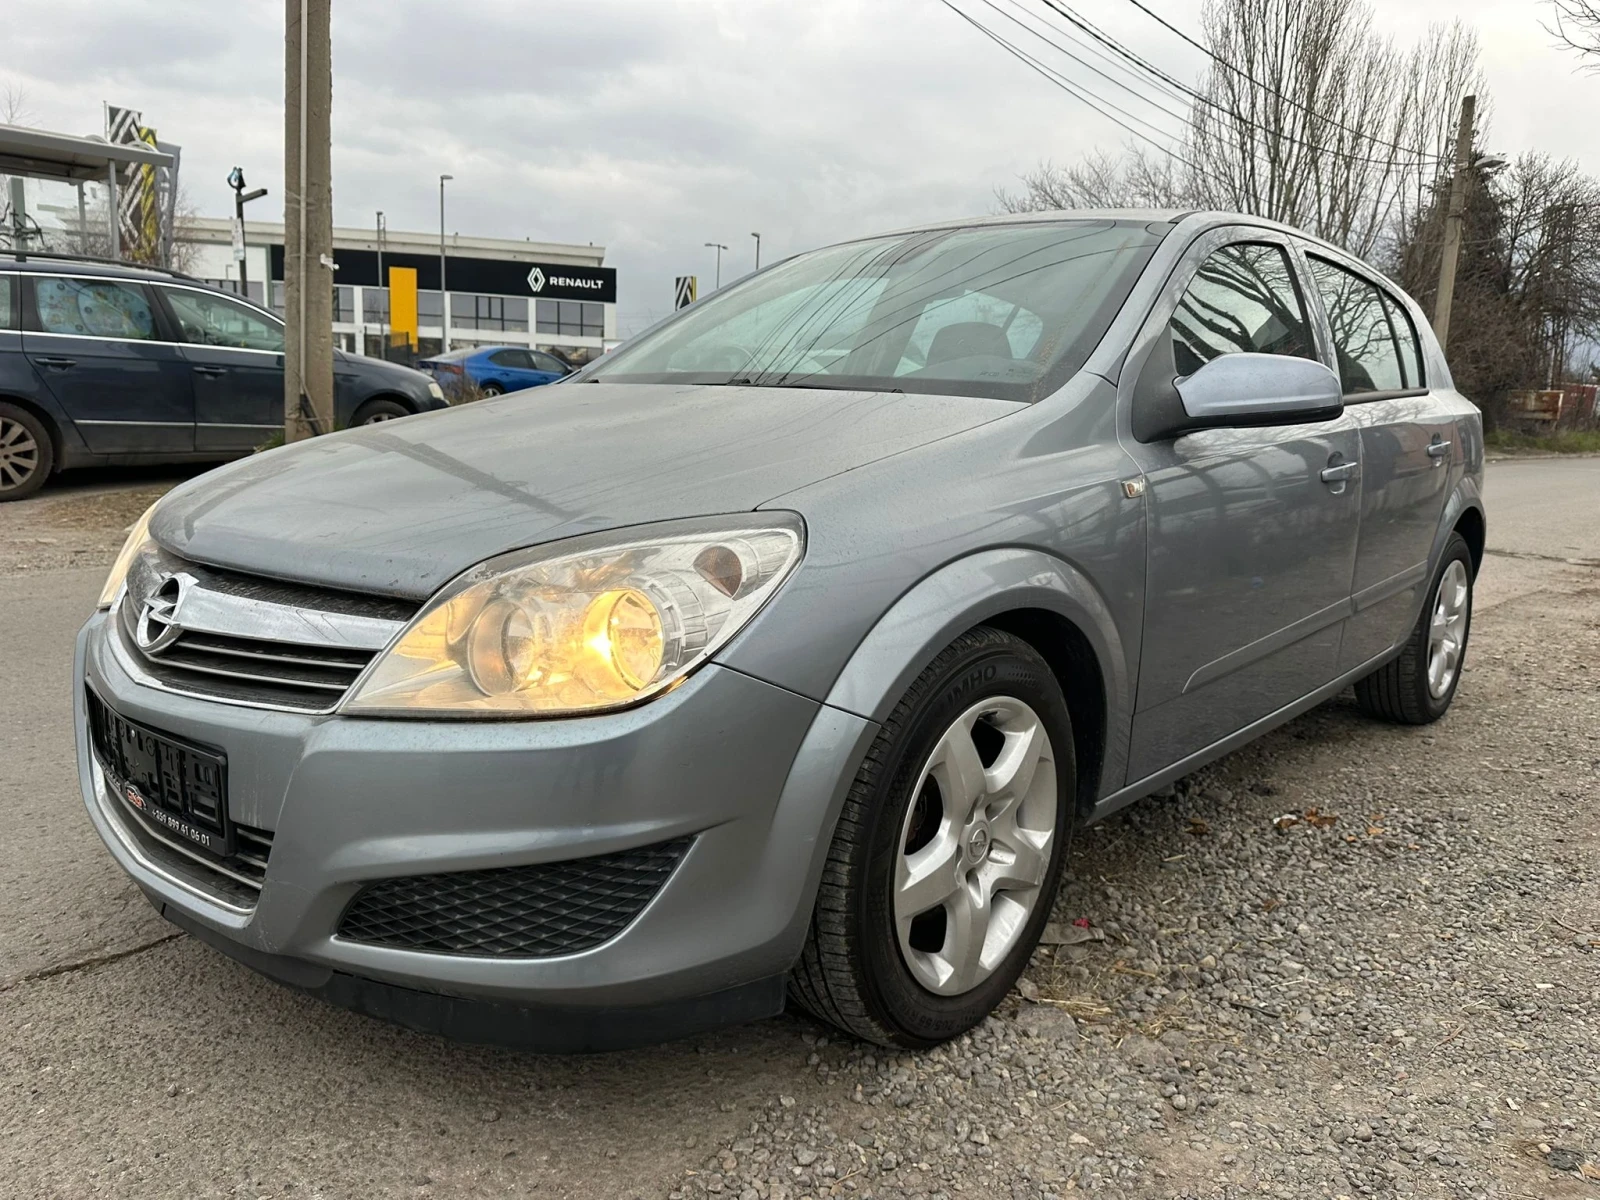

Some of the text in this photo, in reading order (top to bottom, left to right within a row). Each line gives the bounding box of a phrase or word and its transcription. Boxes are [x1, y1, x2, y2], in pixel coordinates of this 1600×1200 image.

[549, 276, 604, 289] RENAULT
[167, 816, 180, 831] 899
[180, 823, 189, 836] 41
[190, 828, 200, 842] 06
[201, 833, 211, 847] 01
